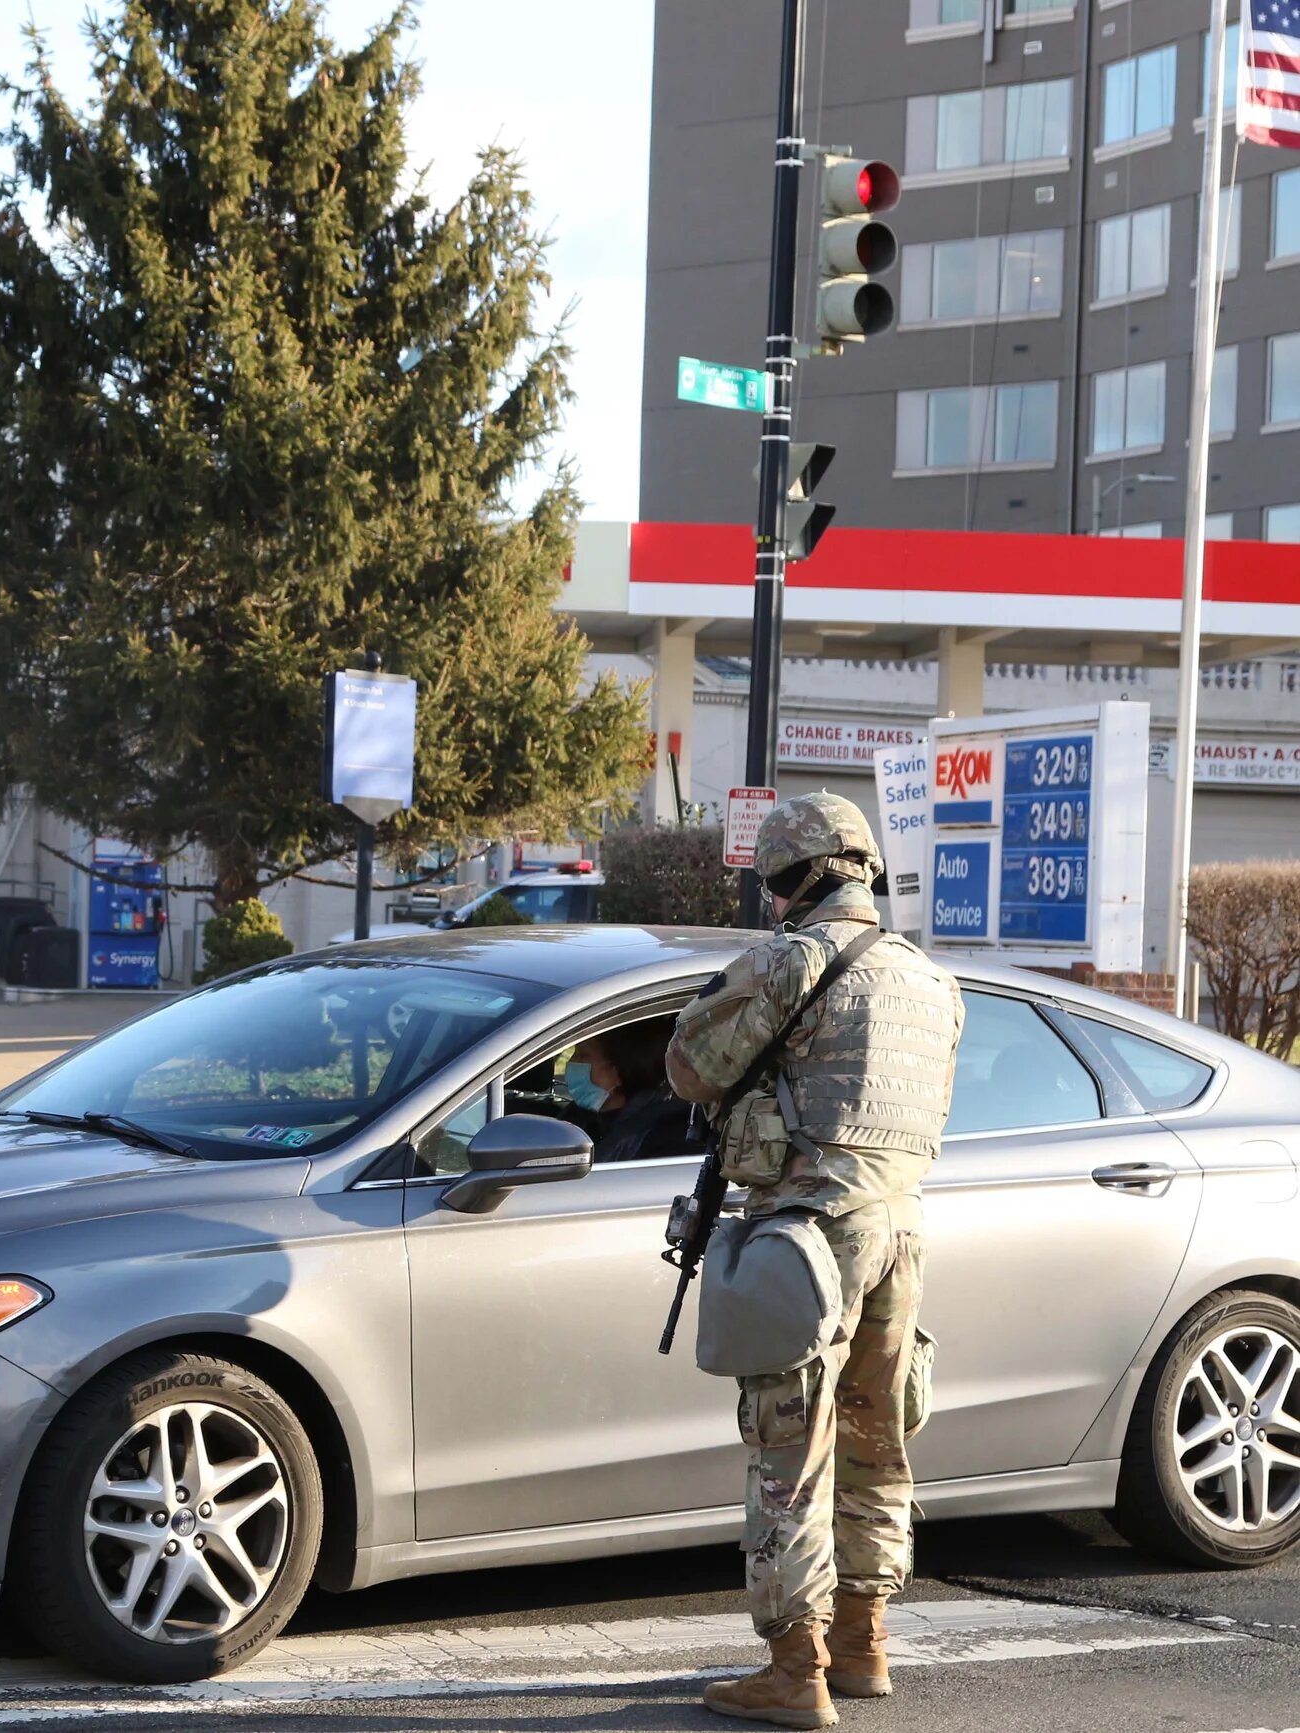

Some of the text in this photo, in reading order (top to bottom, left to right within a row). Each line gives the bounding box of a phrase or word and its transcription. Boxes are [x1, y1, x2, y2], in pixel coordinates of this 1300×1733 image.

[785, 724, 913, 745] CHANGE BRAKES
[778, 742, 791, 757] RY
[795, 743, 849, 760] SCHEDULED
[935, 746, 992, 800] EXXON
[1033, 745, 1076, 787] 329
[745, 801, 757, 810] NO
[1029, 801, 1073, 840] 349
[936, 851, 969, 879] Auto
[1028, 856, 1071, 900] 389
[935, 898, 982, 927] Service
[110, 952, 156, 968] Synergy
